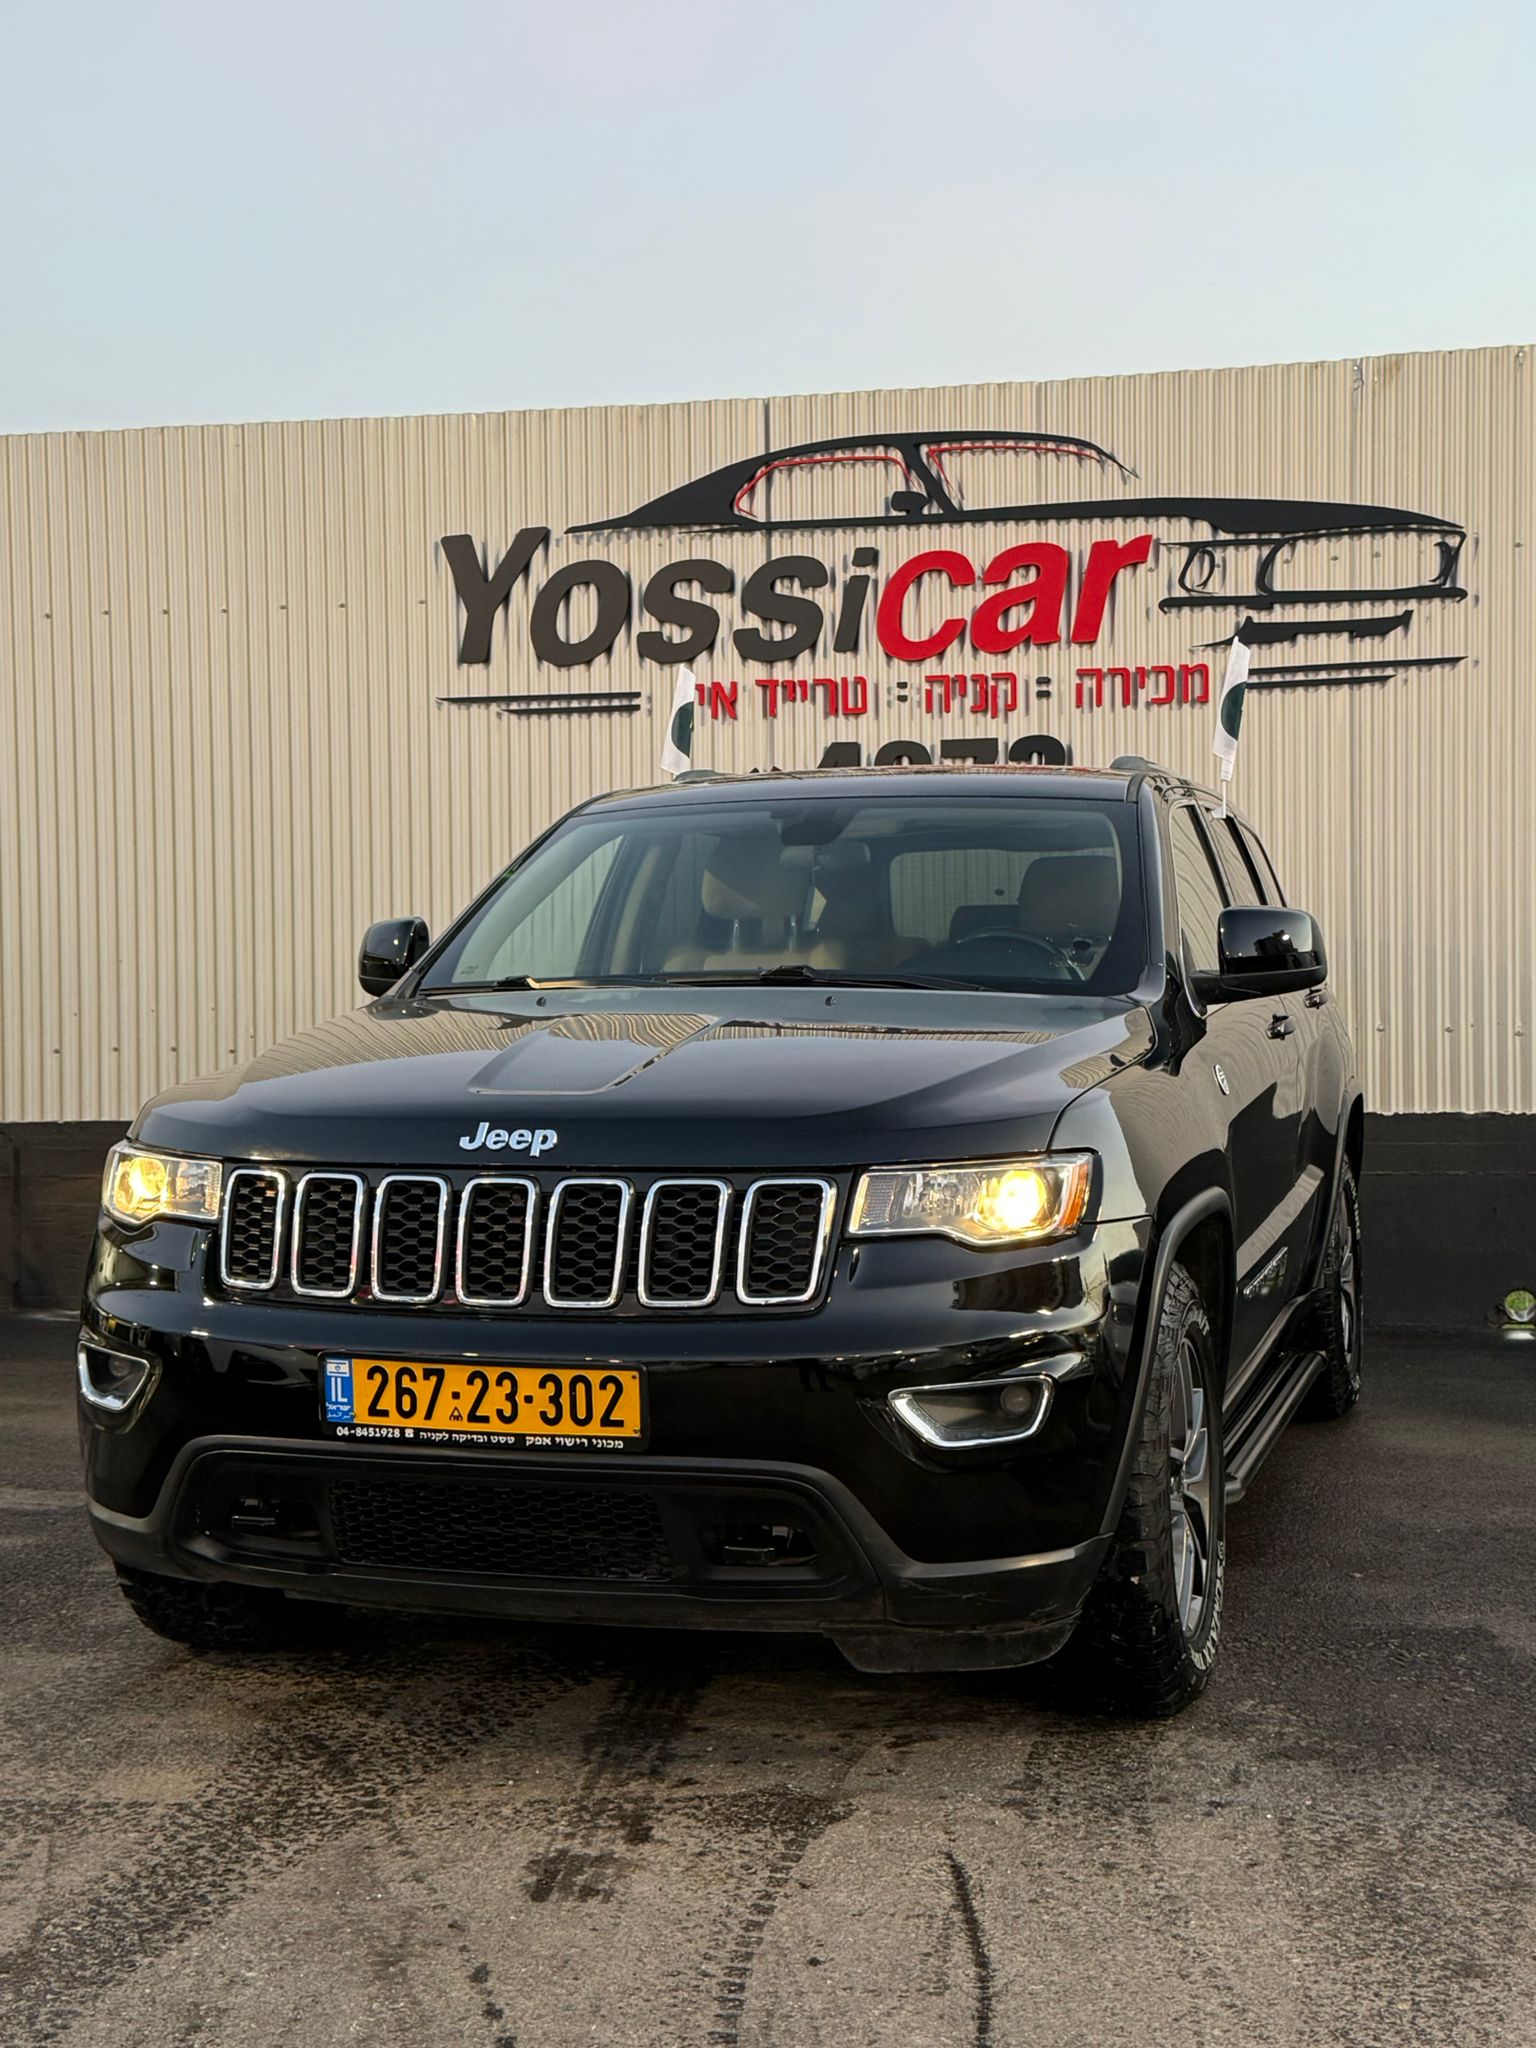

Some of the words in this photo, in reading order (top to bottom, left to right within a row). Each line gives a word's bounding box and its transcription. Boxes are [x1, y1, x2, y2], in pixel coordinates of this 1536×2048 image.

[1075, 662, 1210, 709] מכירה
[695, 681, 738, 720] אי
[754, 675, 868, 718] טרייד
[924, 671, 1018, 719] קניה
[459, 1122, 558, 1157] Jeep
[331, 1377, 348, 1402] IL
[336, 1426, 401, 1438] 04-8451928
[419, 1431, 449, 1442] לקניה
[490, 1434, 515, 1444] טסט
[525, 1435, 552, 1446] אפק
[555, 1436, 588, 1447] רישוי
[591, 1437, 624, 1449] מכוני
